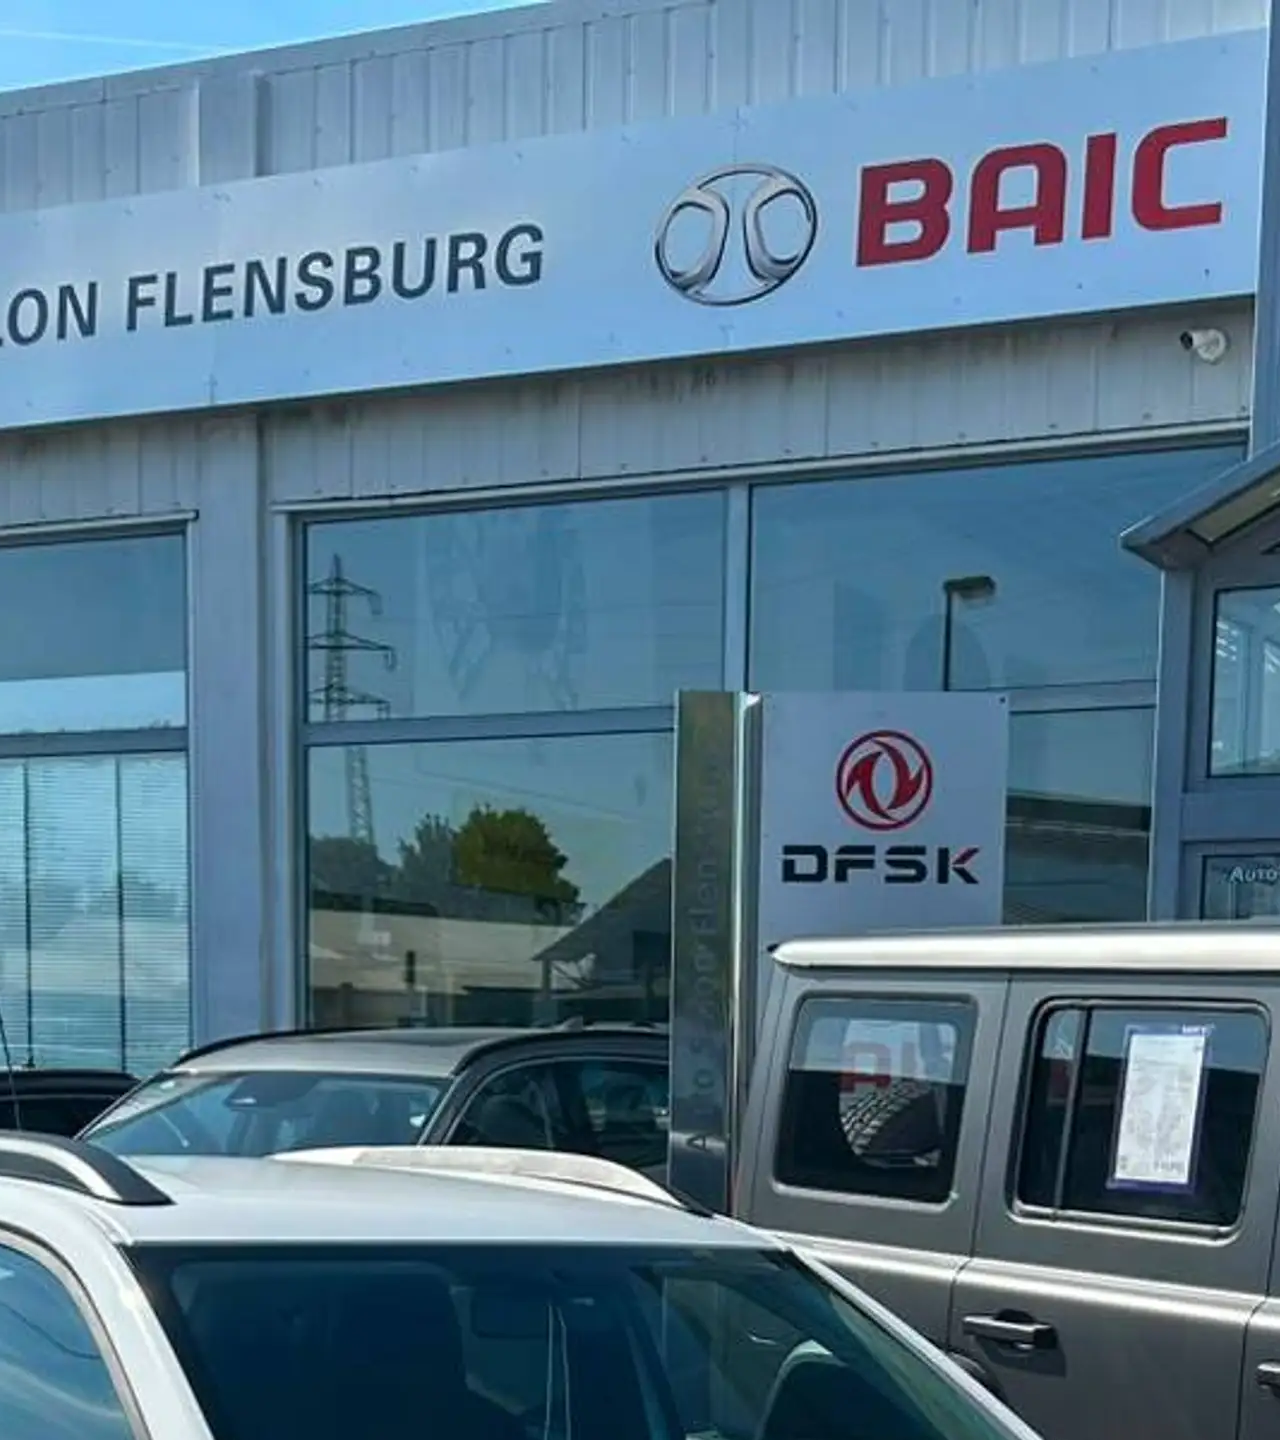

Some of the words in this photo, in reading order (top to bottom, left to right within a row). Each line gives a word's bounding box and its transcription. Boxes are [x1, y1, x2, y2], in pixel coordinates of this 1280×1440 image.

[856, 116, 1228, 268] BAIC
[126, 224, 544, 331] FLENSBURG
[781, 843, 981, 885] DFSK
